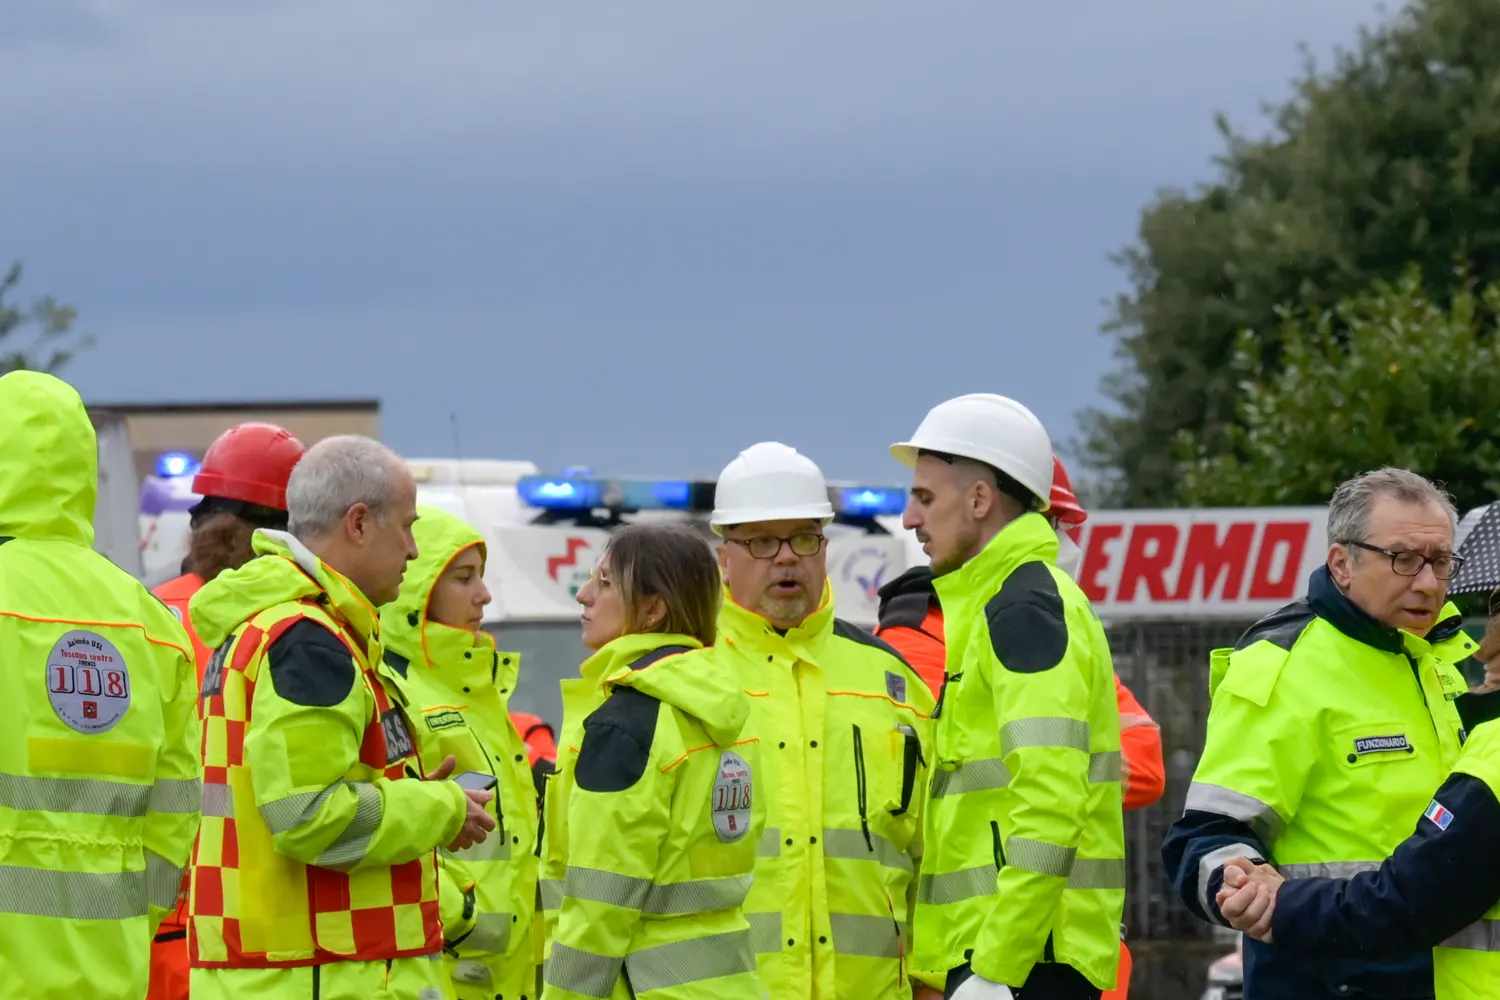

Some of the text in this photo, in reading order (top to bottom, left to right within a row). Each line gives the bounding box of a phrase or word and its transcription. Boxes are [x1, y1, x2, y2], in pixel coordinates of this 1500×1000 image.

[1067, 521, 1311, 603] ERMO
[61, 648, 88, 660] Toscana
[55, 666, 123, 697] 118
[1356, 737, 1406, 752] FUNZIONARIO
[716, 783, 751, 810] 118
